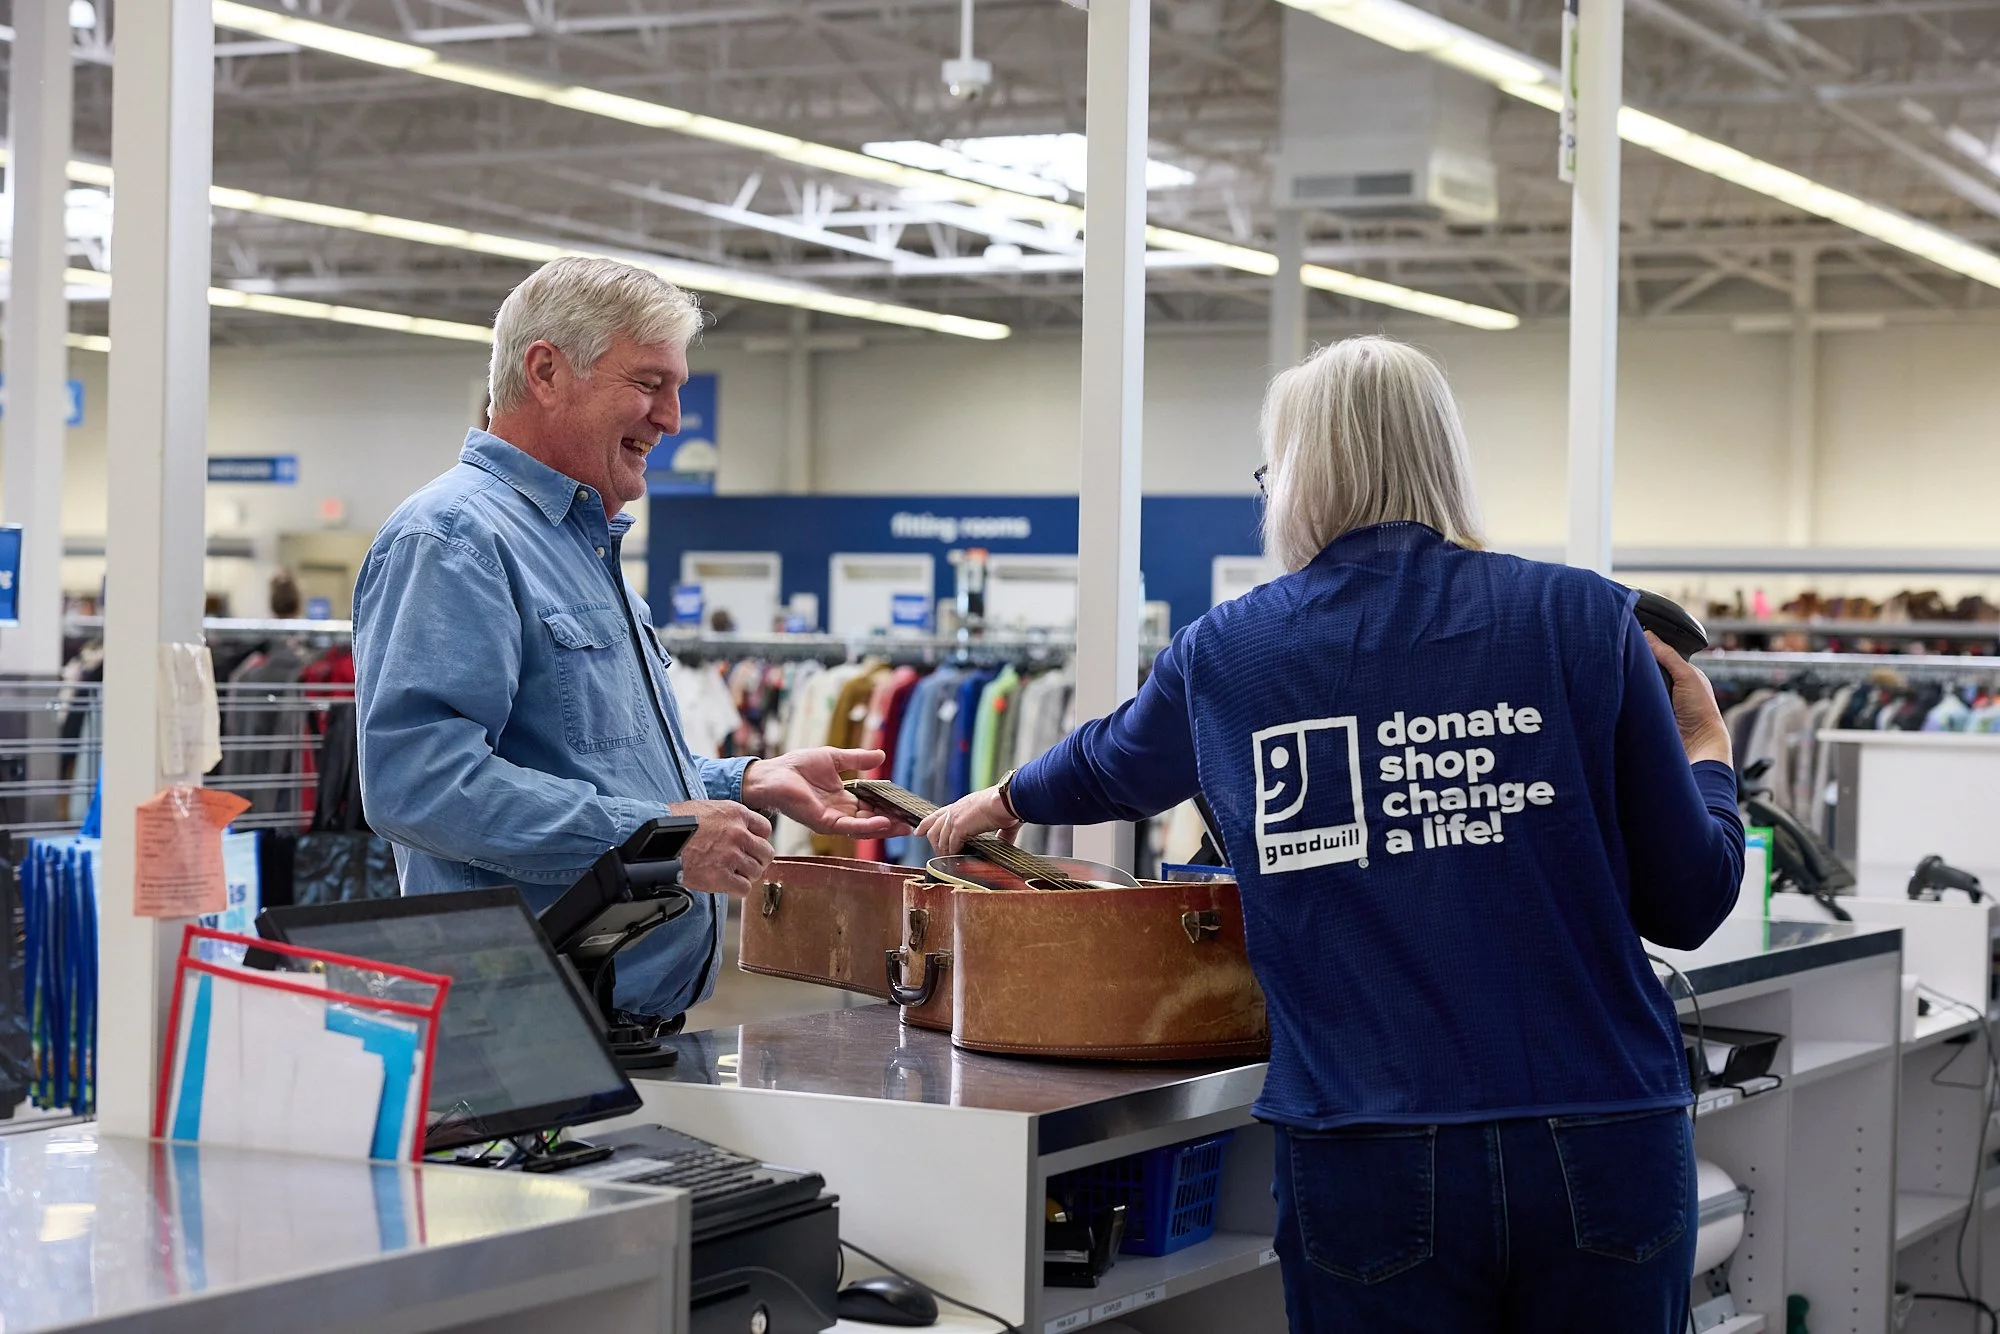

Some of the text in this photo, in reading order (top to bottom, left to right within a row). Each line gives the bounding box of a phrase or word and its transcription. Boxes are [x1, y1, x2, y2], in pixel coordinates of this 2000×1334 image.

[959, 516, 1031, 539] rooms
[1377, 702, 1542, 746] donate
[1379, 746, 1495, 783] shop
[1382, 781, 1555, 817] change
[1265, 828, 1360, 866] goodwill
[1385, 811, 1505, 854] a life!
